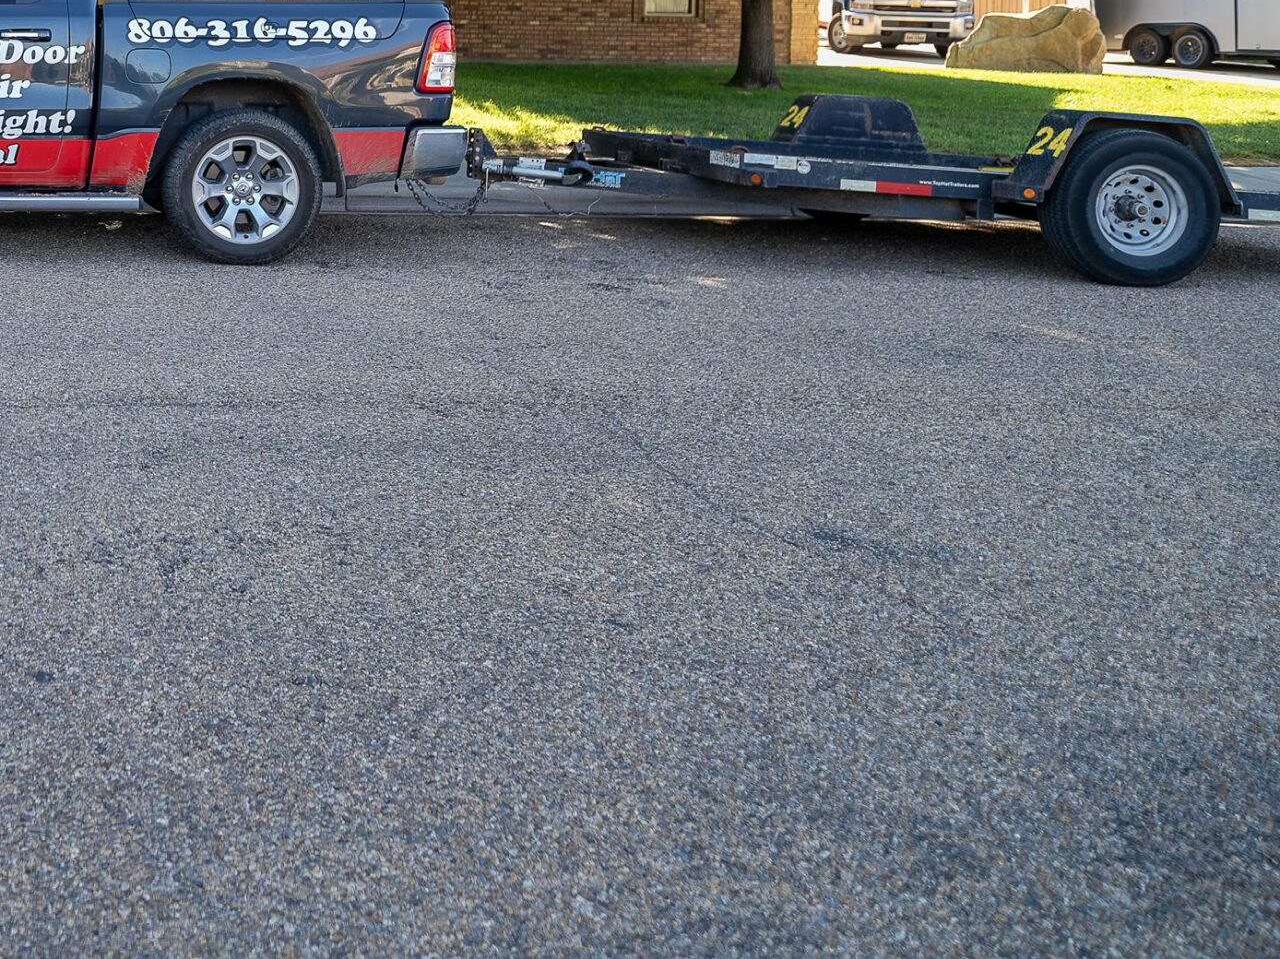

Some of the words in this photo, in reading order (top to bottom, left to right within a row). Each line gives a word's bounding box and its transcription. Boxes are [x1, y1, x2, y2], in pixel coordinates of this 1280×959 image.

[128, 17, 377, 47] 806-316-5296
[780, 105, 810, 128] 24
[1026, 126, 1073, 158] 24
